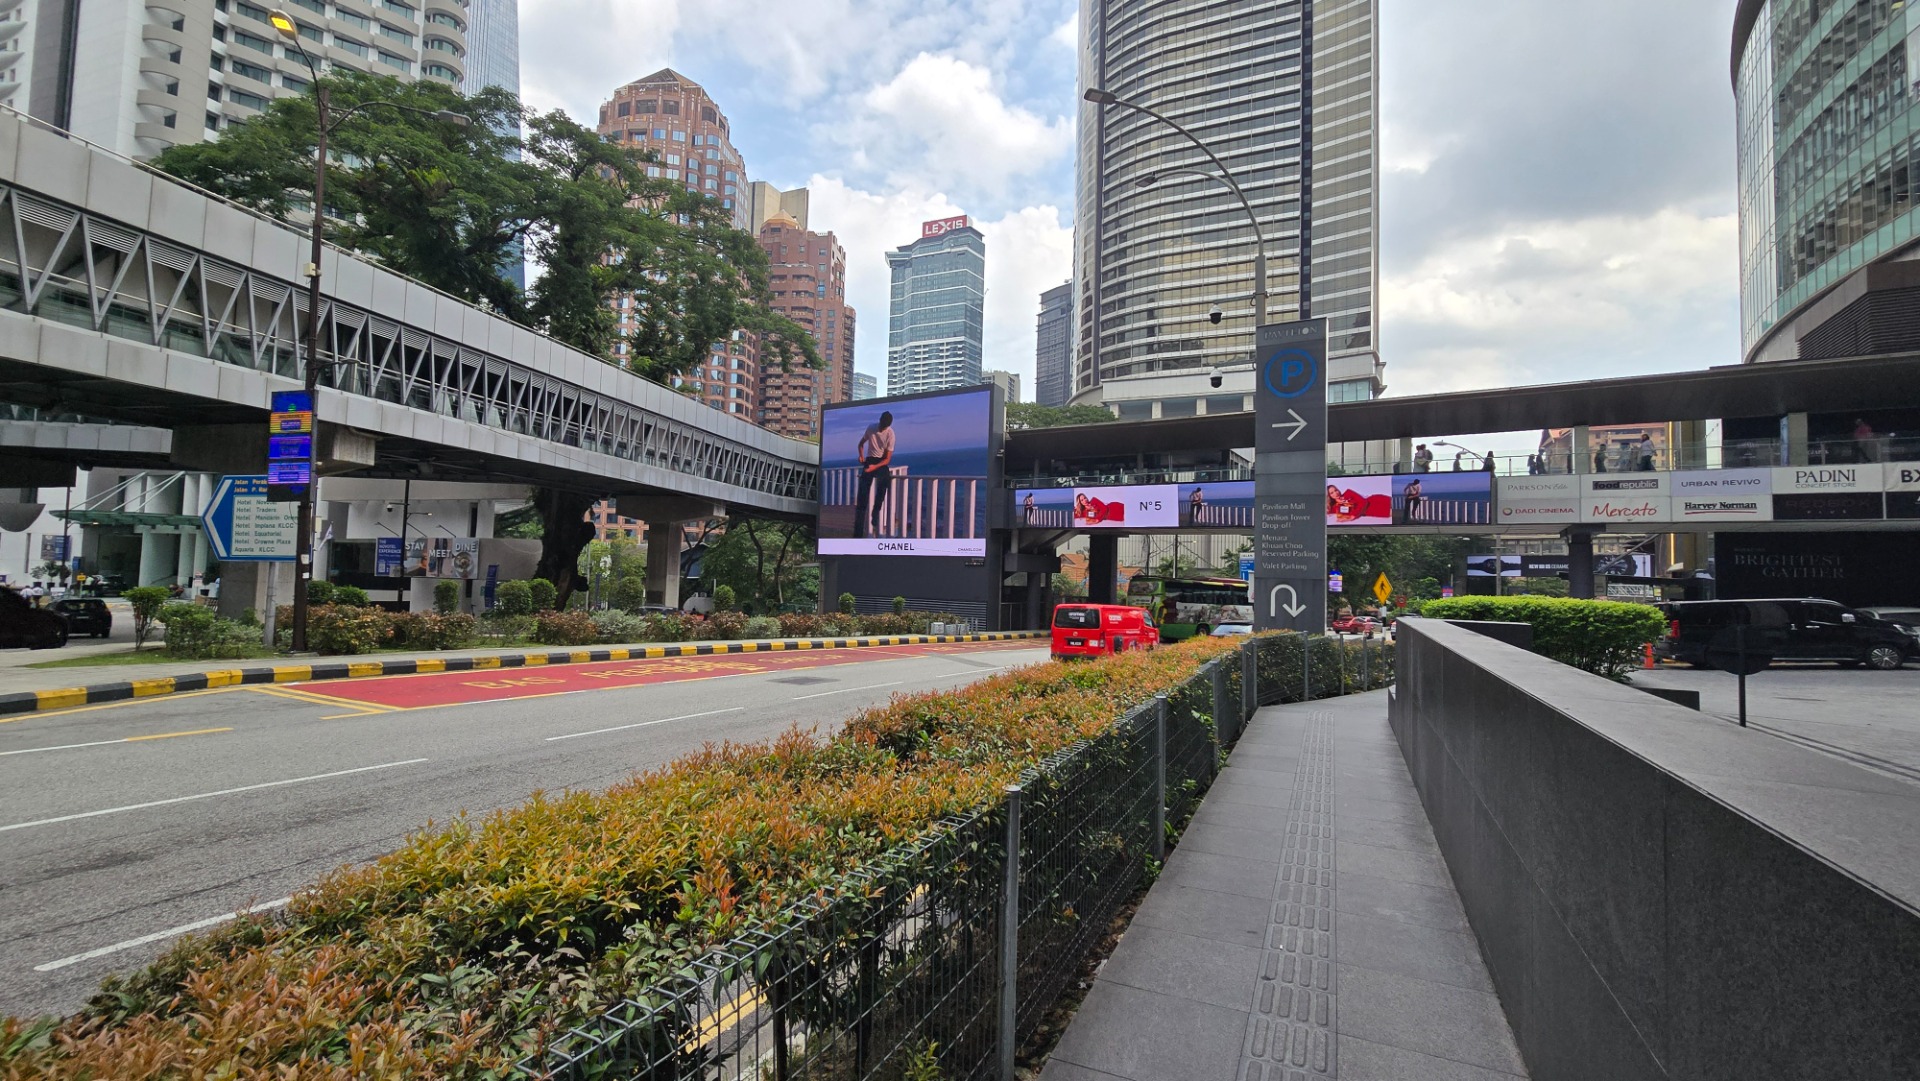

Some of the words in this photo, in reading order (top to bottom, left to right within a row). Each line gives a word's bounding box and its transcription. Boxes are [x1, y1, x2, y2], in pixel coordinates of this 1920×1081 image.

[925, 220, 963, 235] LEXIS
[1264, 326, 1317, 339] PAVILION
[1282, 360, 1304, 387] P
[1795, 469, 1856, 483] PADINI
[1592, 502, 1658, 517] Mercato
[1684, 502, 1717, 510] Harvey
[1719, 502, 1757, 510] Norman
[406, 542, 425, 550] STAY
[455, 543, 477, 551] DINE
[878, 542, 915, 550] CHANEL
[428, 550, 450, 558] MEET
[1292, 550, 1319, 559] Parking
[1735, 554, 1841, 566] BRIGHTEST
[1281, 562, 1308, 570] Parking
[1762, 567, 1844, 578] GATHER
